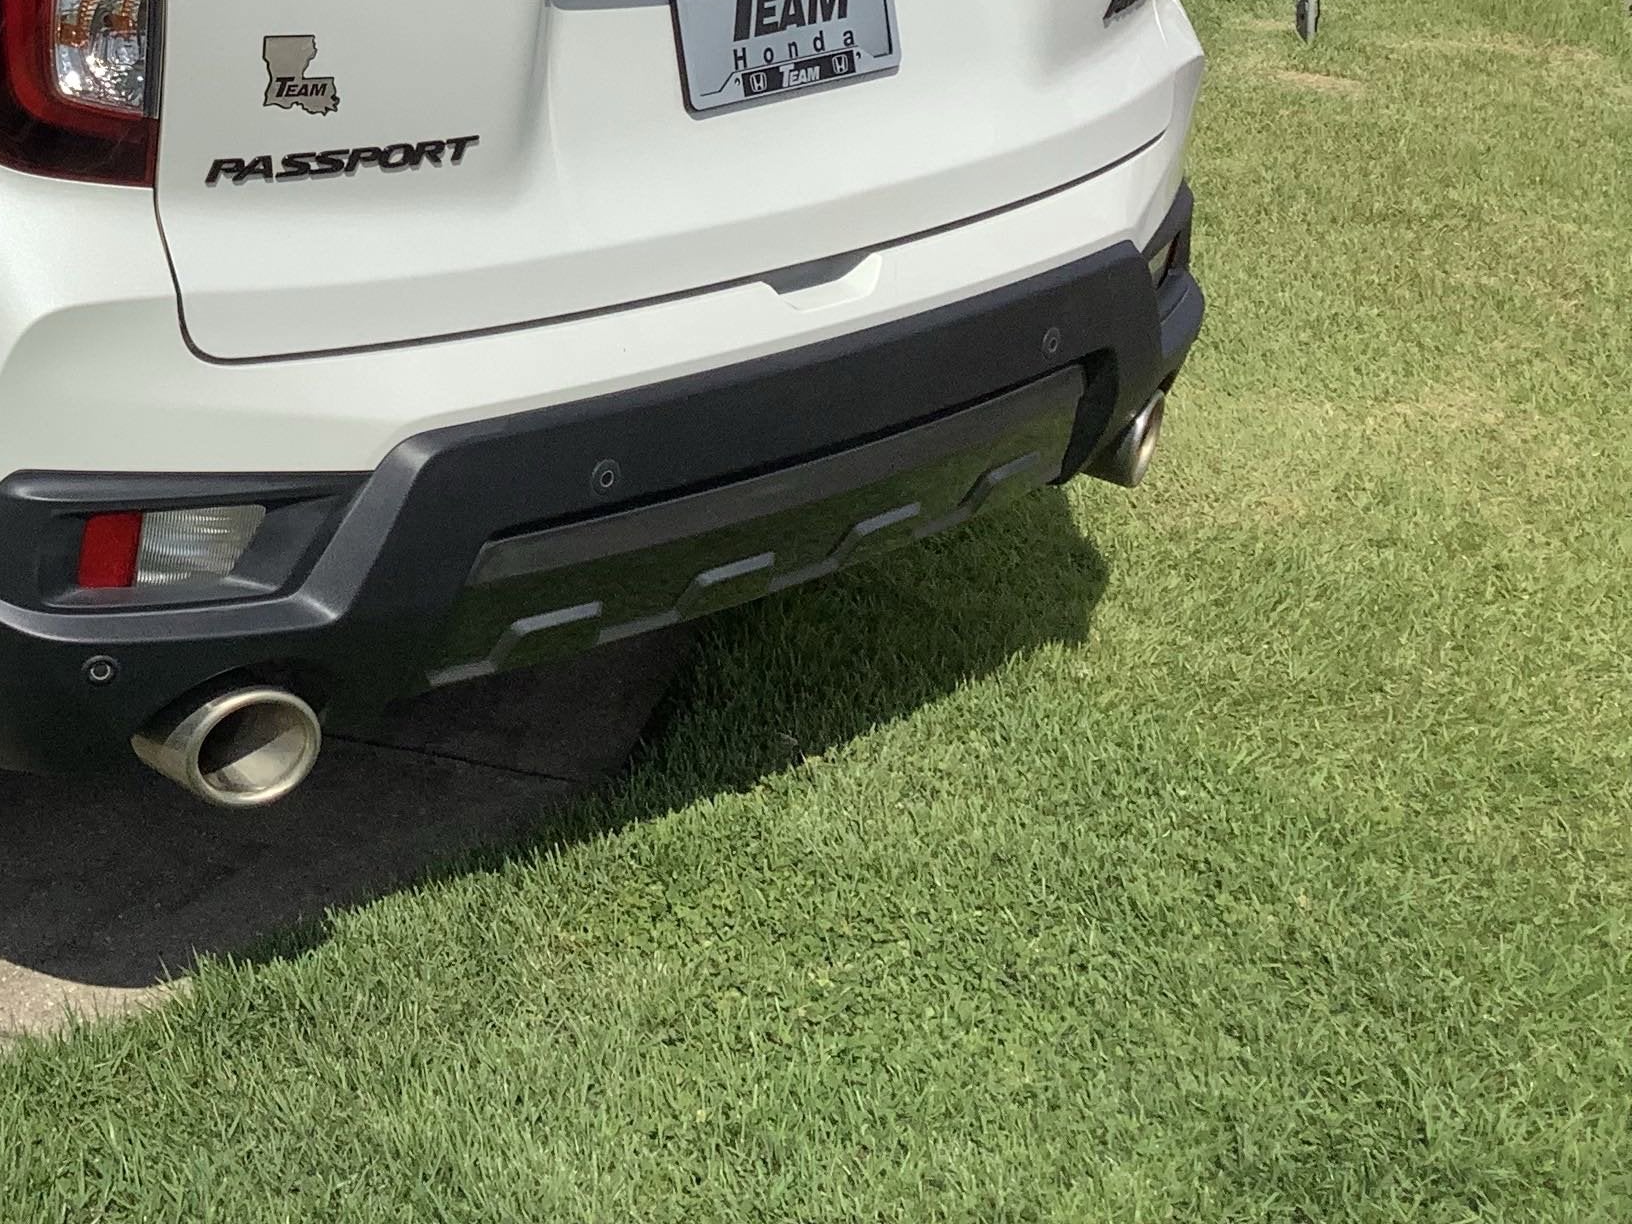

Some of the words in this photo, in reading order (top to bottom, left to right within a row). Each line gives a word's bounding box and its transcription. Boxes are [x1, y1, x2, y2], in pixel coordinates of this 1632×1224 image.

[733, 30, 856, 70] Honda
[275, 77, 327, 97] TEAM
[779, 64, 821, 87] TEAM
[205, 135, 480, 185] PASSPORT
